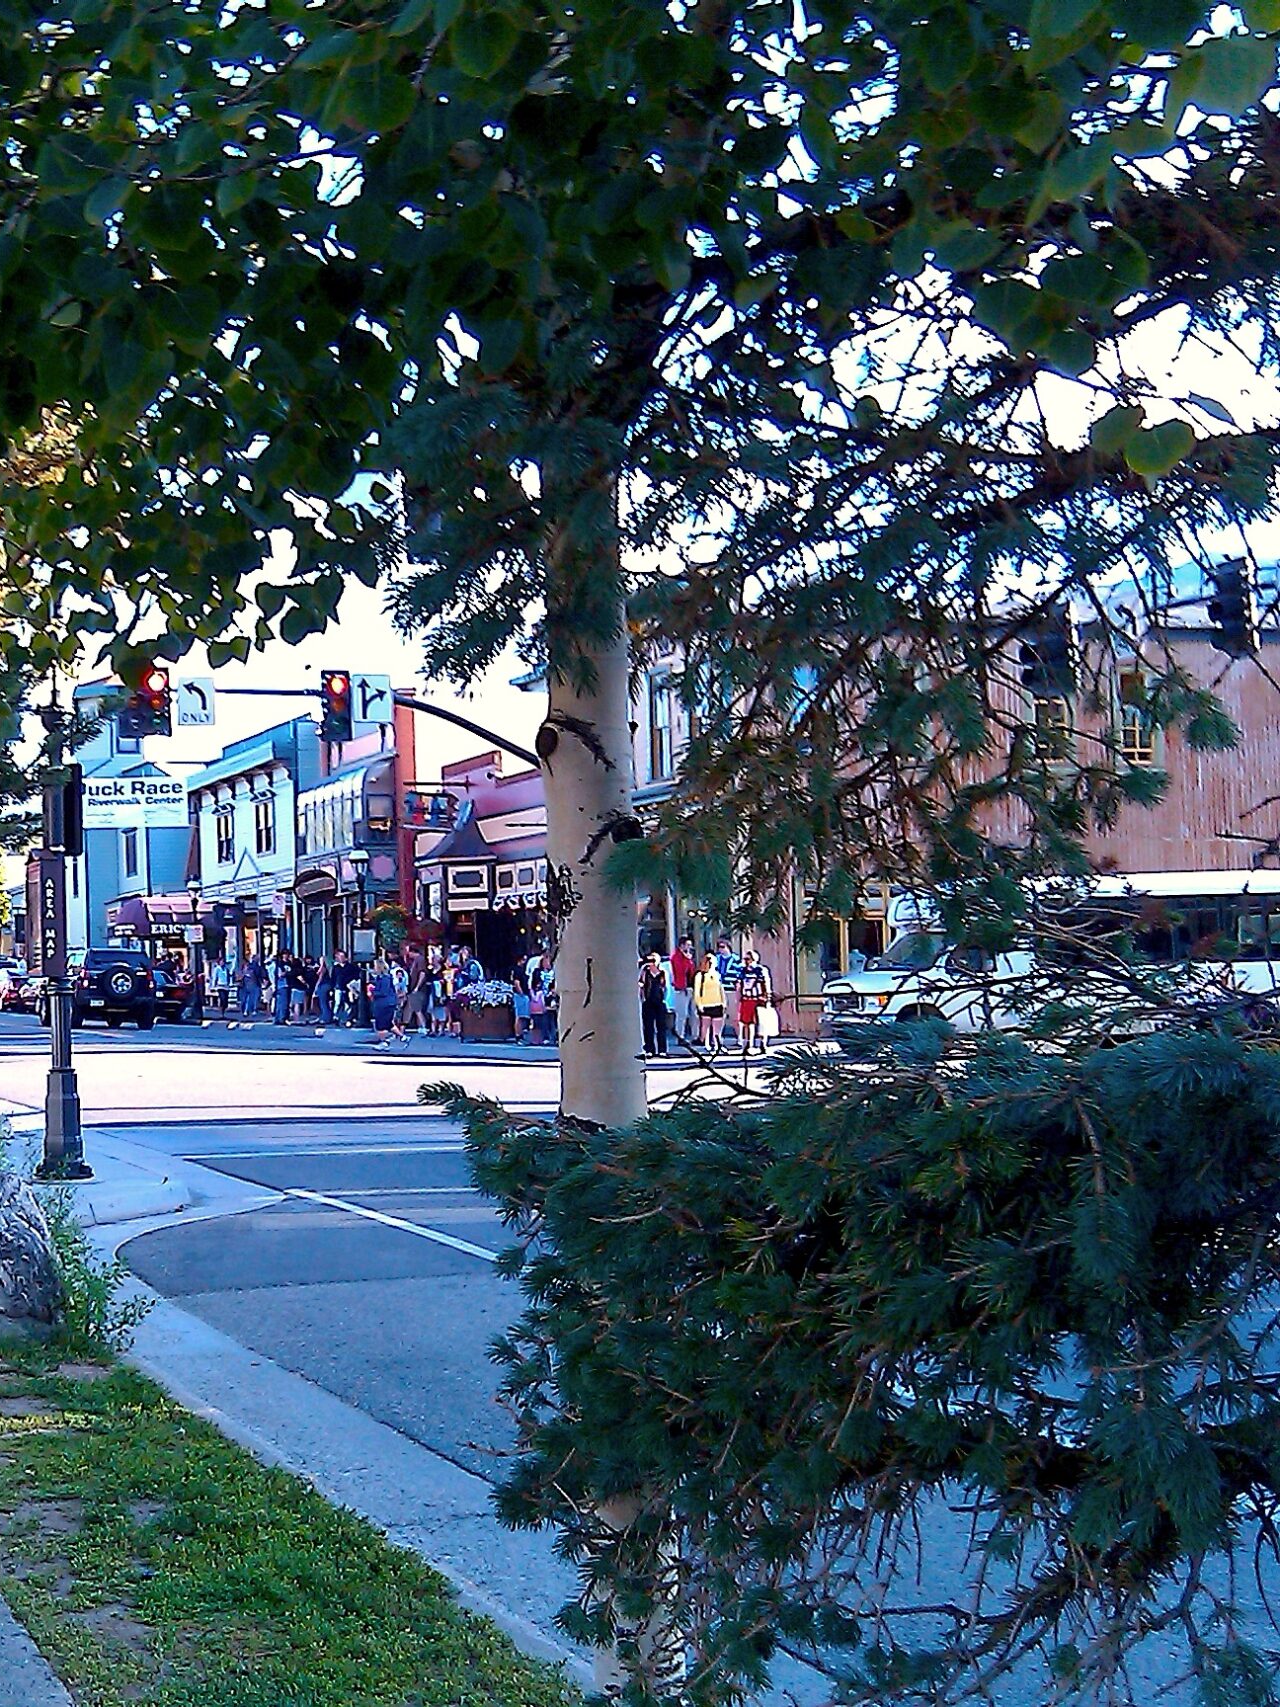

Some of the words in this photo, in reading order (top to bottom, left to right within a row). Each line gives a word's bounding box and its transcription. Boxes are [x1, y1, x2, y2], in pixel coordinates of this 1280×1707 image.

[182, 712, 209, 723] ONLY
[131, 781, 183, 794] Race
[88, 797, 141, 806] Riverwalk
[145, 796, 184, 805] Center
[45, 879, 55, 918] AREA
[45, 929, 56, 958] MAP
